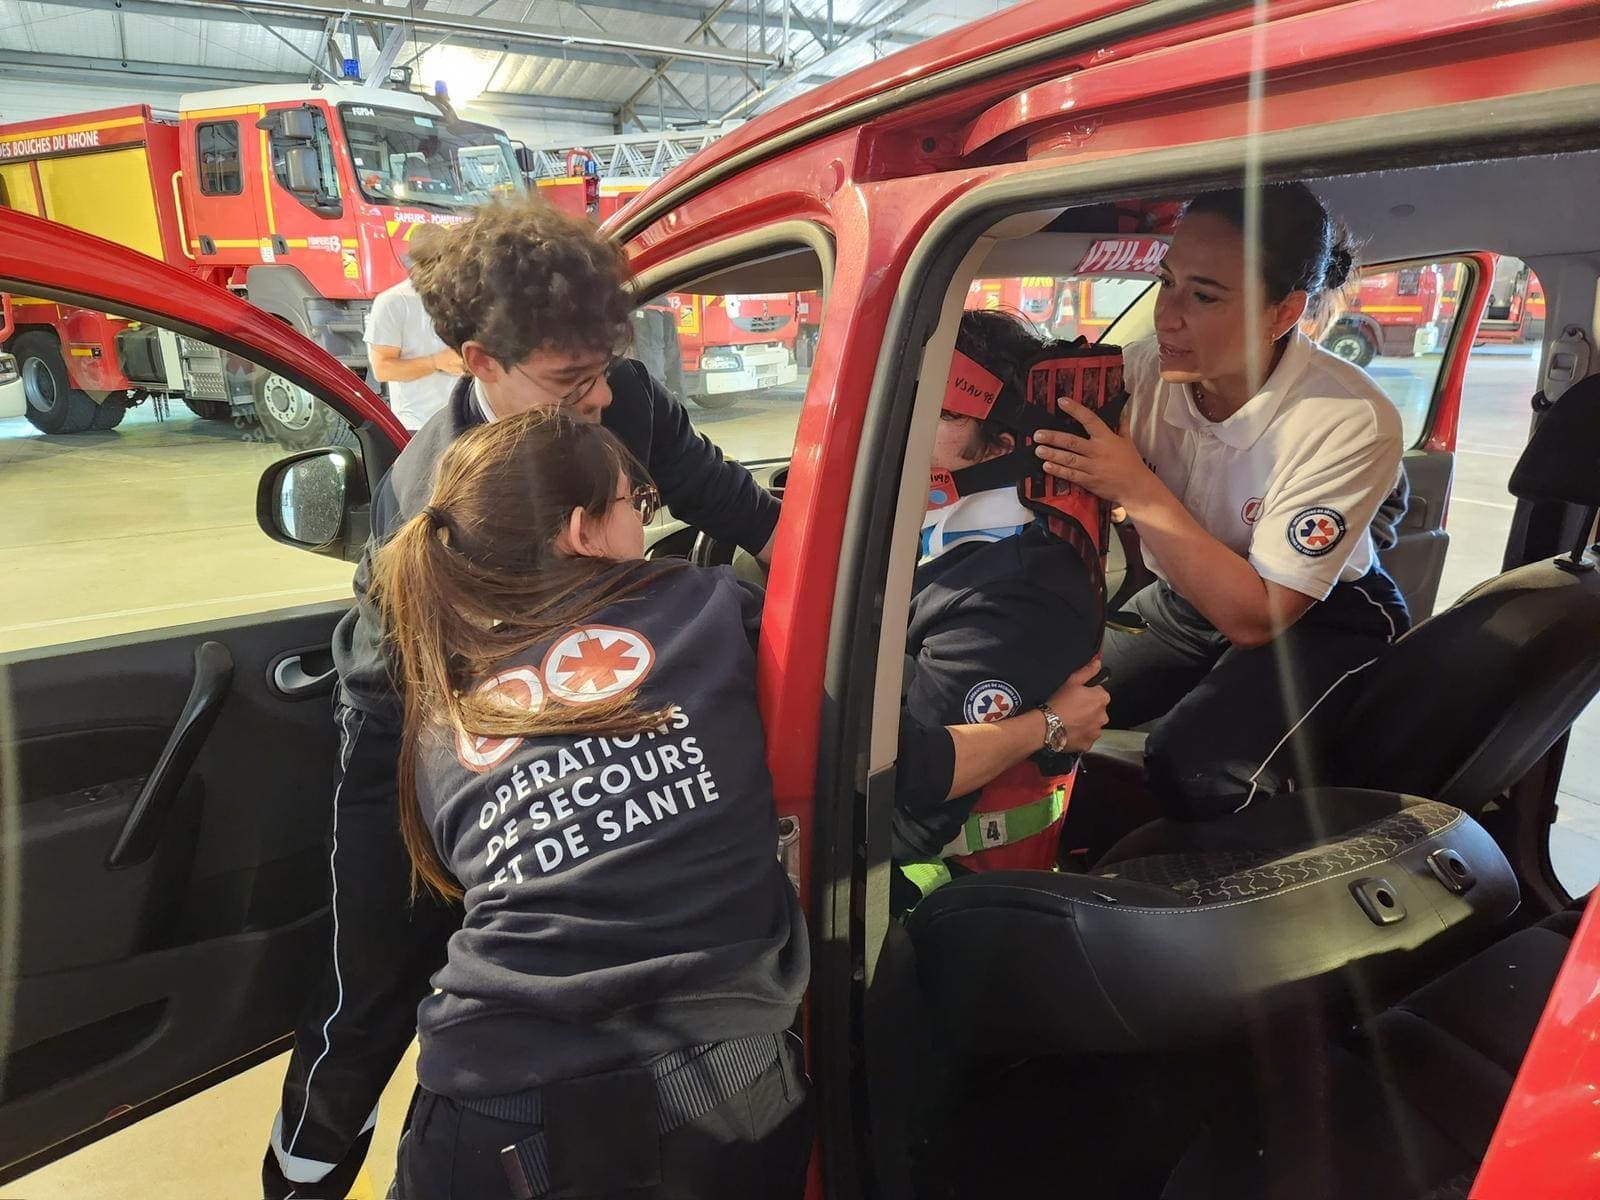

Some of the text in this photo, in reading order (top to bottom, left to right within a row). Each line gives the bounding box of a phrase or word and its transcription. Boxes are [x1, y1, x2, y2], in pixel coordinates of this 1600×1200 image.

[13, 137, 51, 155] BOUCHES
[53, 135, 65, 150] DU
[394, 211, 426, 223] SAPEURS
[485, 736, 704, 867] DE SECOURS
[534, 823, 590, 873] DE
[596, 762, 720, 843] SANTÉ
[987, 820, 1001, 841] 4
